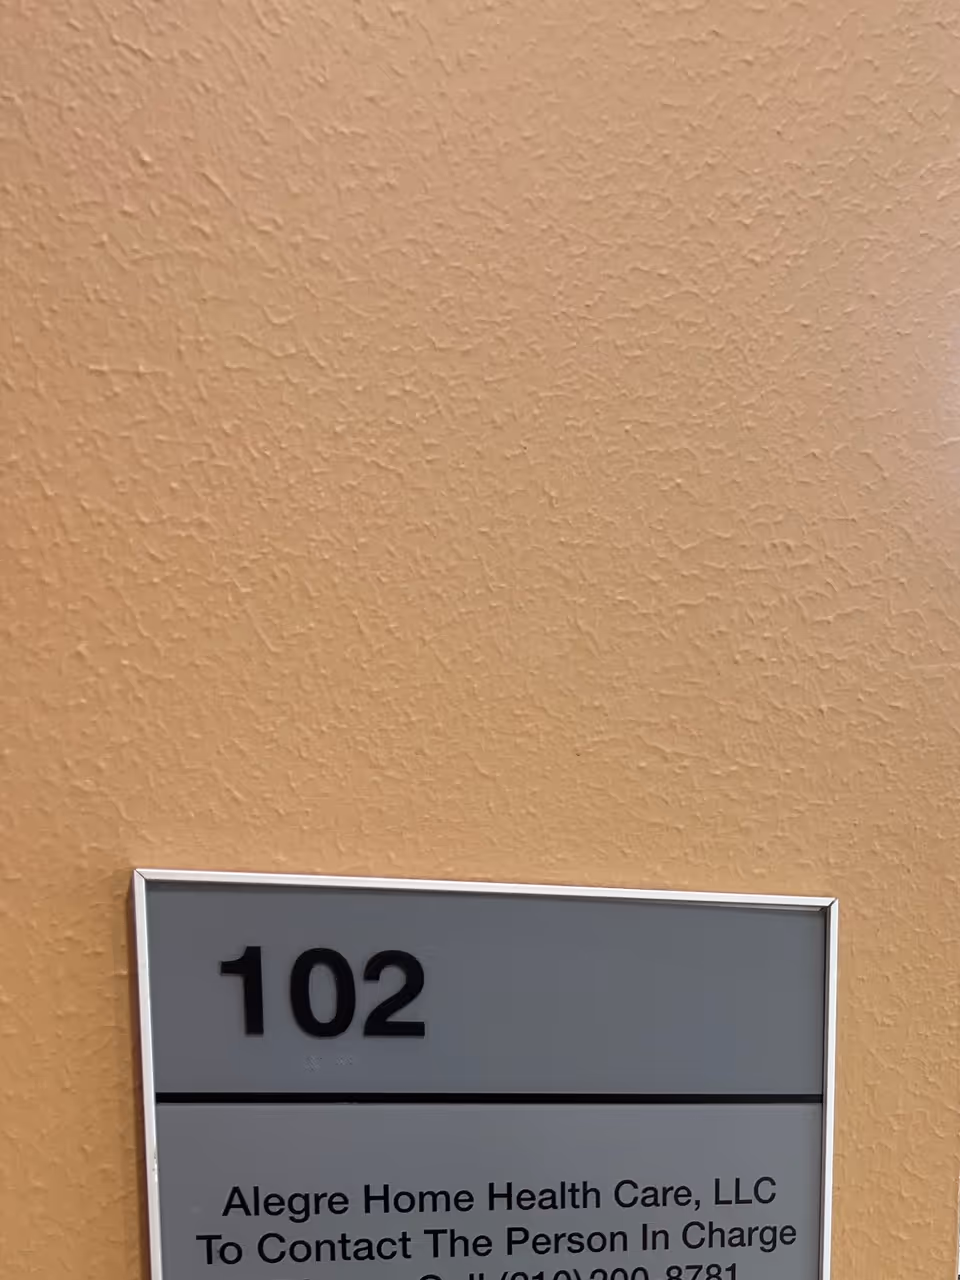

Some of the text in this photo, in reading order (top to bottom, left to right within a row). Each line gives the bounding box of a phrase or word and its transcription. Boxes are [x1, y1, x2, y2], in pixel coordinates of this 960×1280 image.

[219, 946, 425, 1040] 102
[222, 1177, 776, 1223] Alegre Home Health Care, LLC
[196, 1221, 796, 1264] To Contact The Person In Charge
